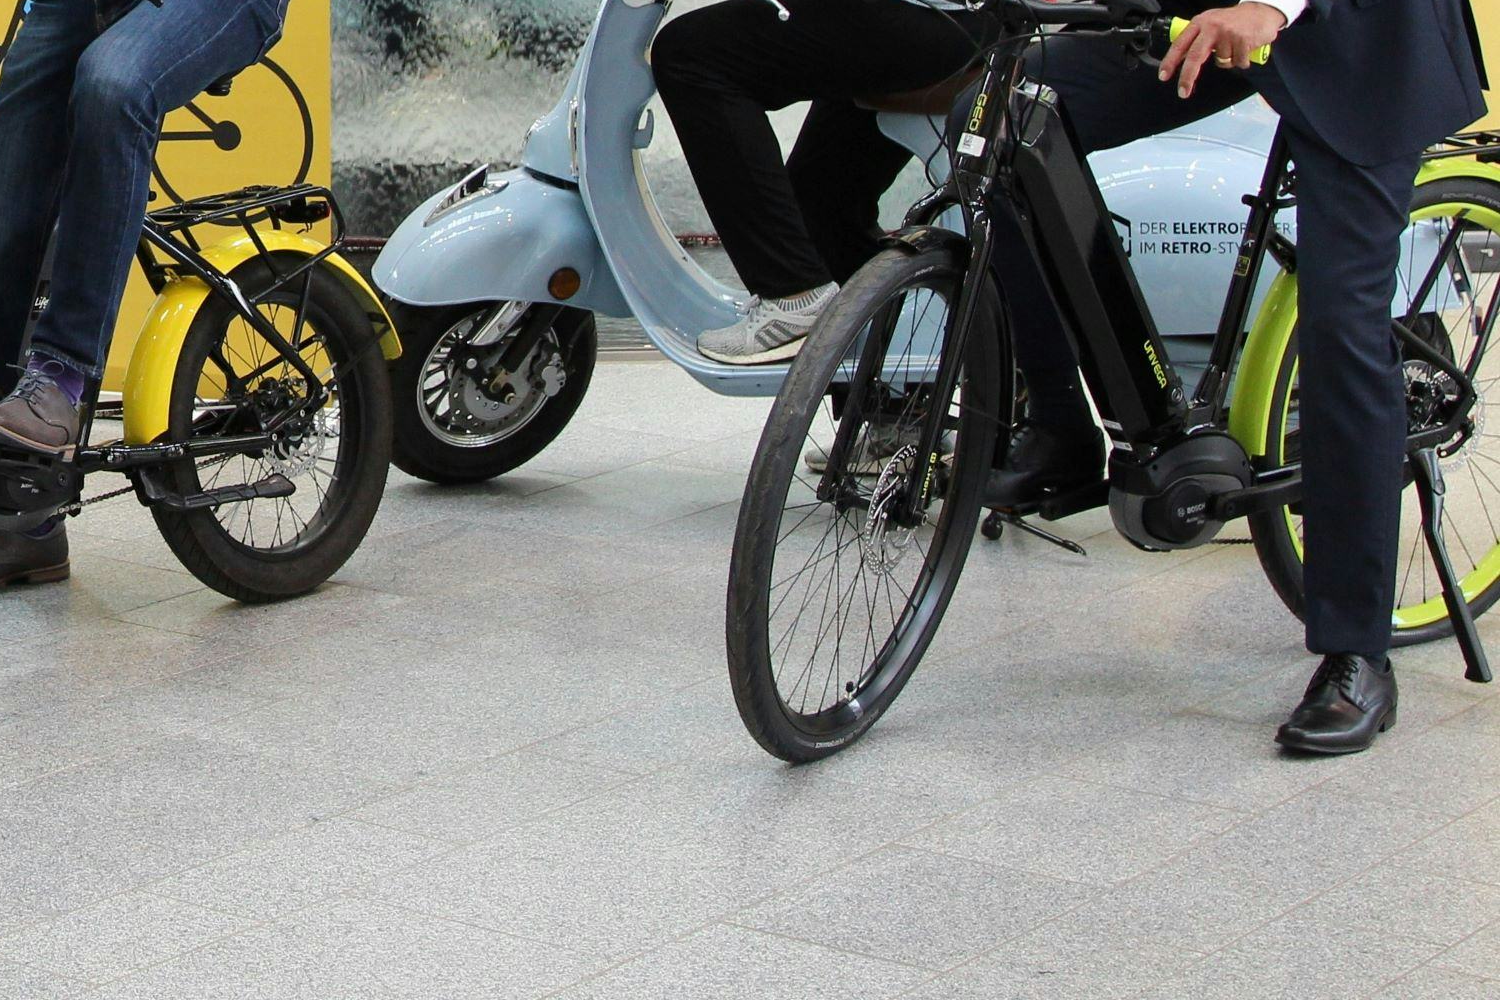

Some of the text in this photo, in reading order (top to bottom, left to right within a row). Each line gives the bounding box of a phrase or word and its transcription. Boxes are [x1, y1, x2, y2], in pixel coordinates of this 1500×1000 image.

[968, 93, 988, 132] GEO
[1139, 222, 1169, 235] DER
[1139, 242, 1157, 255] IM
[1143, 339, 1168, 389] UNIVEGA
